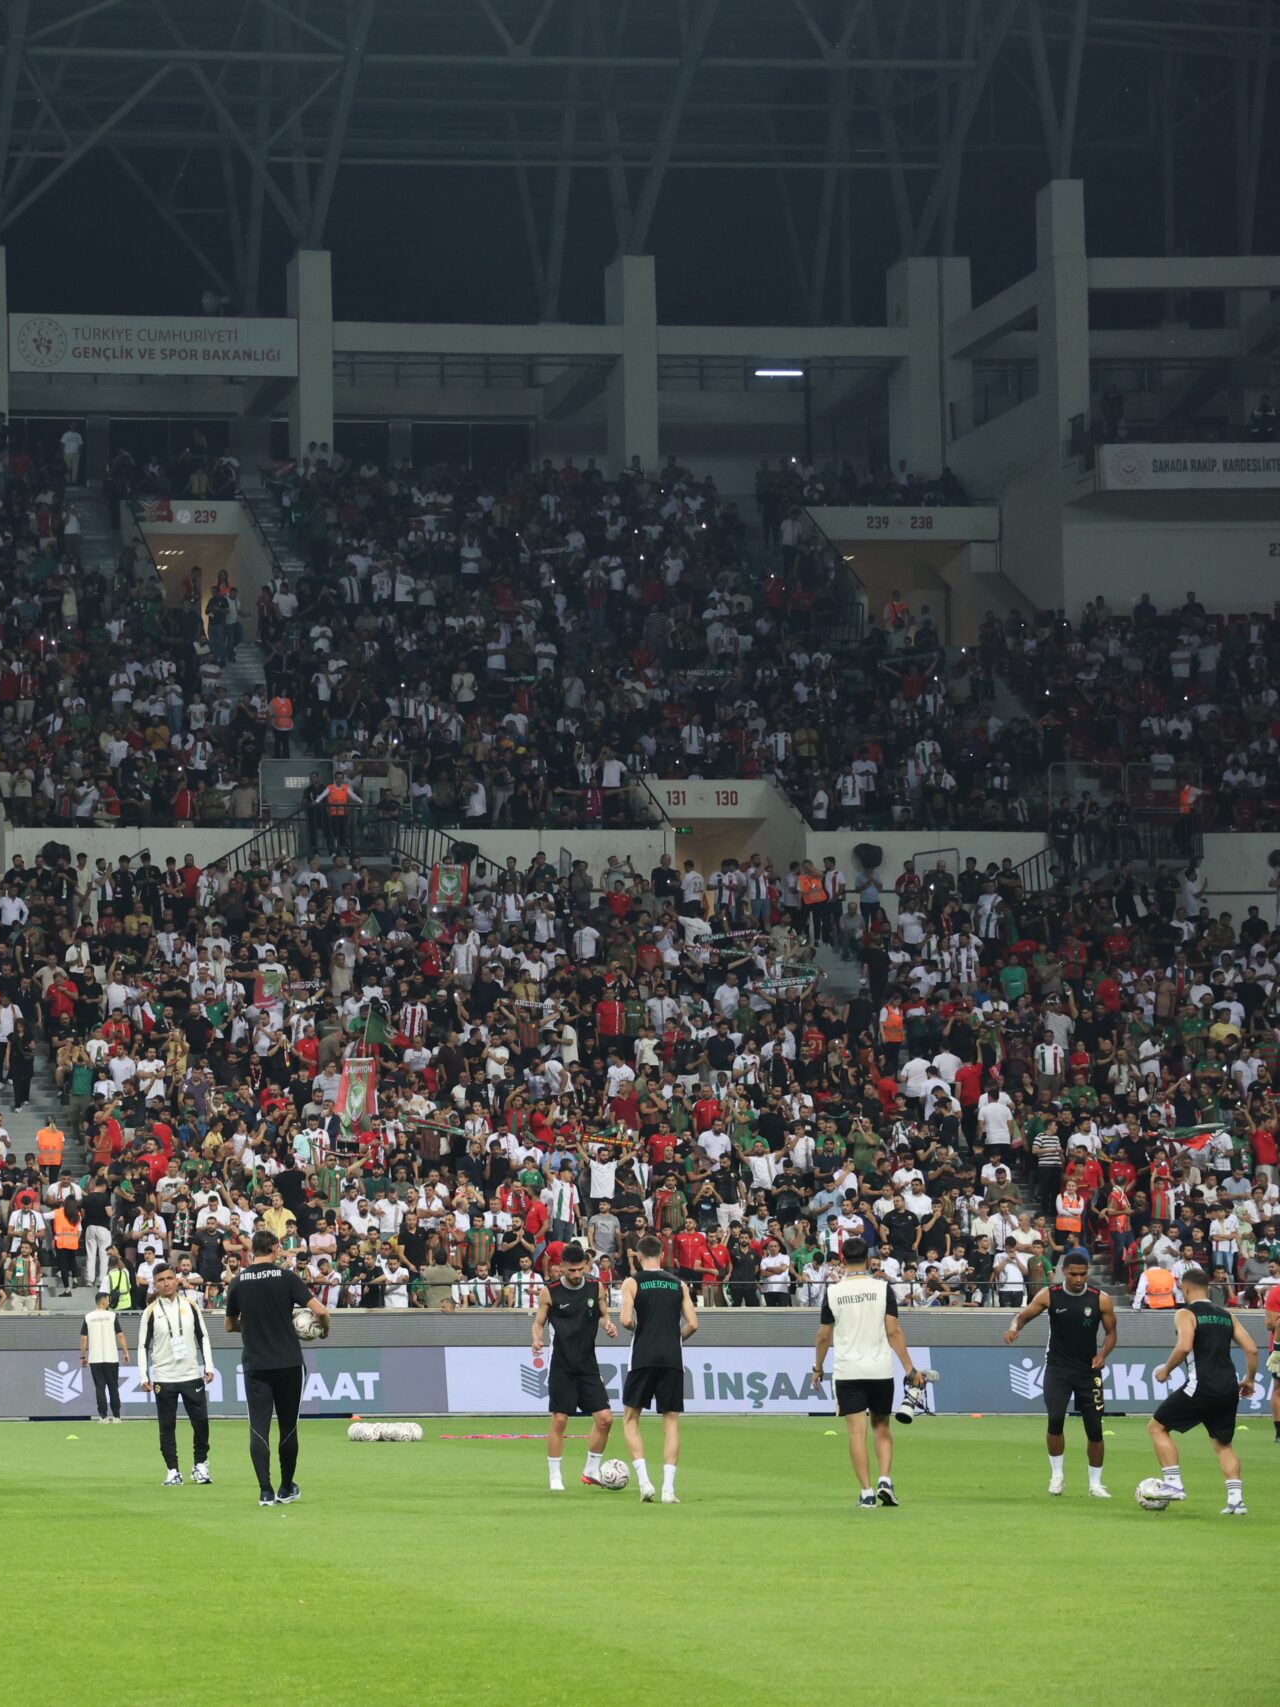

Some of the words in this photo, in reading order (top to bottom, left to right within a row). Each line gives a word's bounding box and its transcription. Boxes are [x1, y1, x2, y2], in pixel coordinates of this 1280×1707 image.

[72, 325, 133, 341] TÜRKİYE
[137, 328, 238, 343] CUMHURİYETİ
[72, 346, 135, 362] GENÇLİK
[138, 349, 157, 360] VE
[160, 348, 198, 361] SPOR
[202, 348, 280, 362] BAKANLIĞI
[1152, 459, 1188, 473] SAHADA
[194, 510, 217, 523] 239
[866, 515, 889, 529] 239
[910, 516, 933, 529] 238
[666, 790, 686, 806] 131
[715, 790, 738, 806] 130
[639, 1280, 678, 1291] AMEDSPOR
